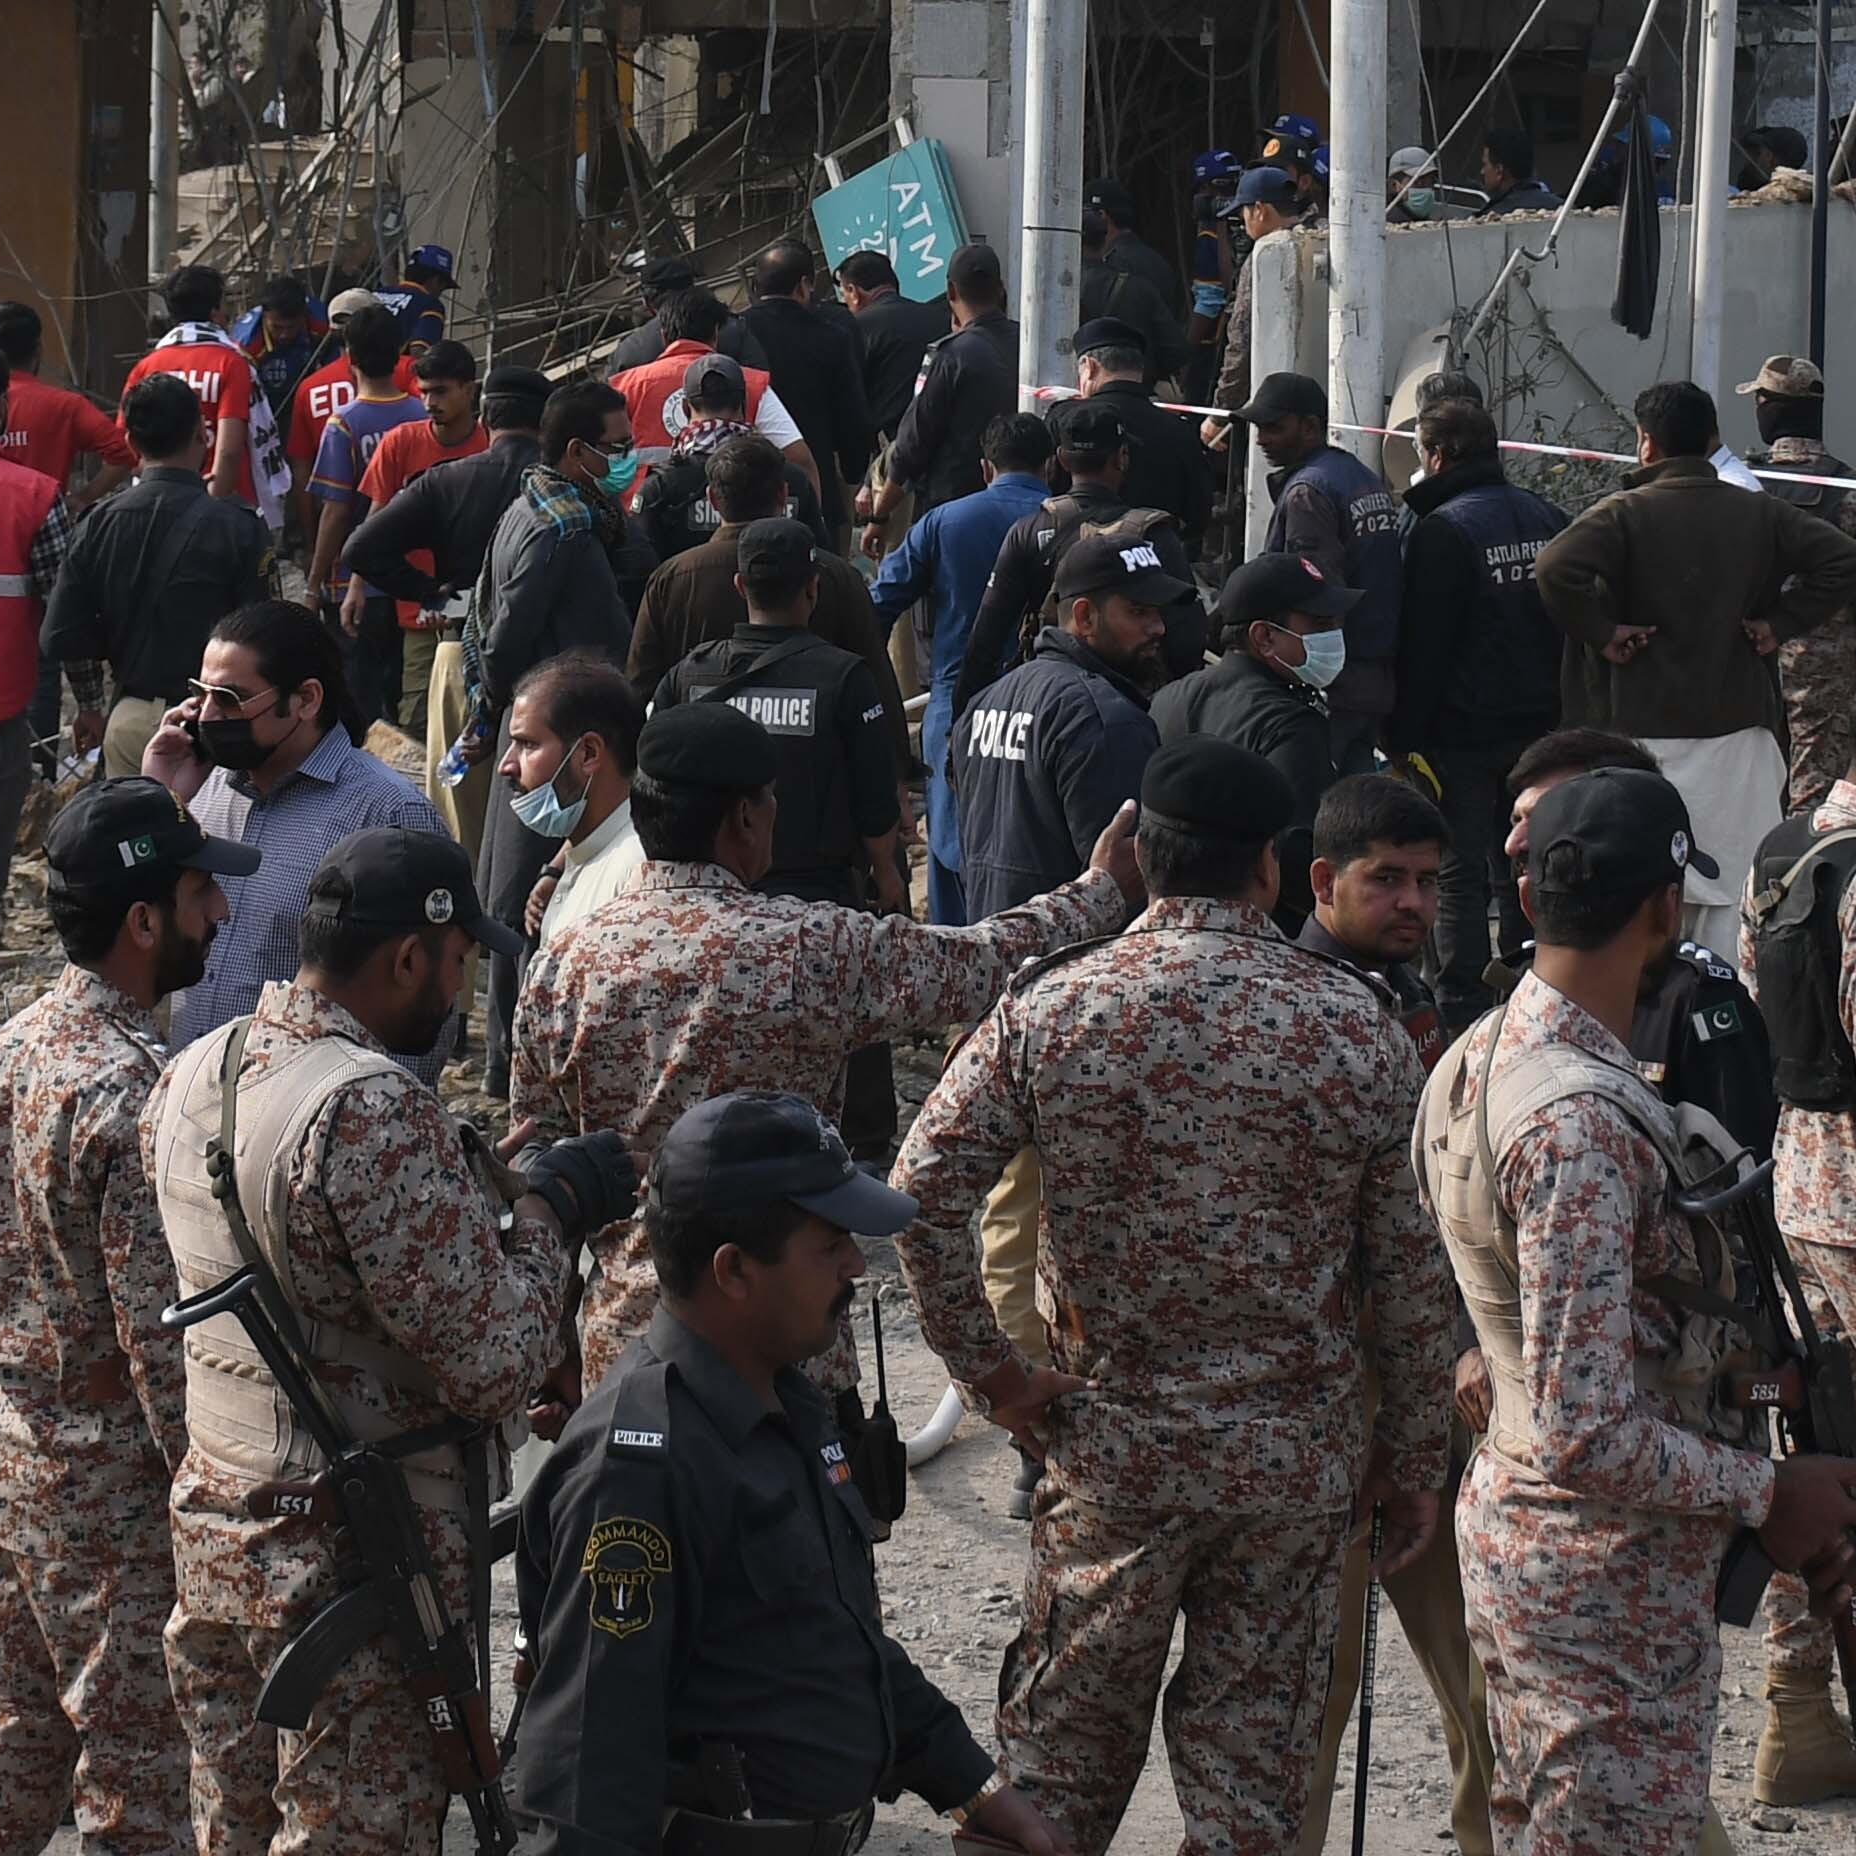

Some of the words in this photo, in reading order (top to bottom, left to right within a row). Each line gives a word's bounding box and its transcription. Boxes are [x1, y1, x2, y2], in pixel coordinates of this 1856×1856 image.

[890, 181, 943, 278] ATM
[751, 697, 811, 726] POLICE
[967, 708, 1033, 761] POLCE
[273, 1495, 313, 1515] 1551
[586, 1524, 665, 1561] COMMANDO
[598, 1572, 647, 1585] EAGLET
[427, 1695, 454, 1733] 1551
